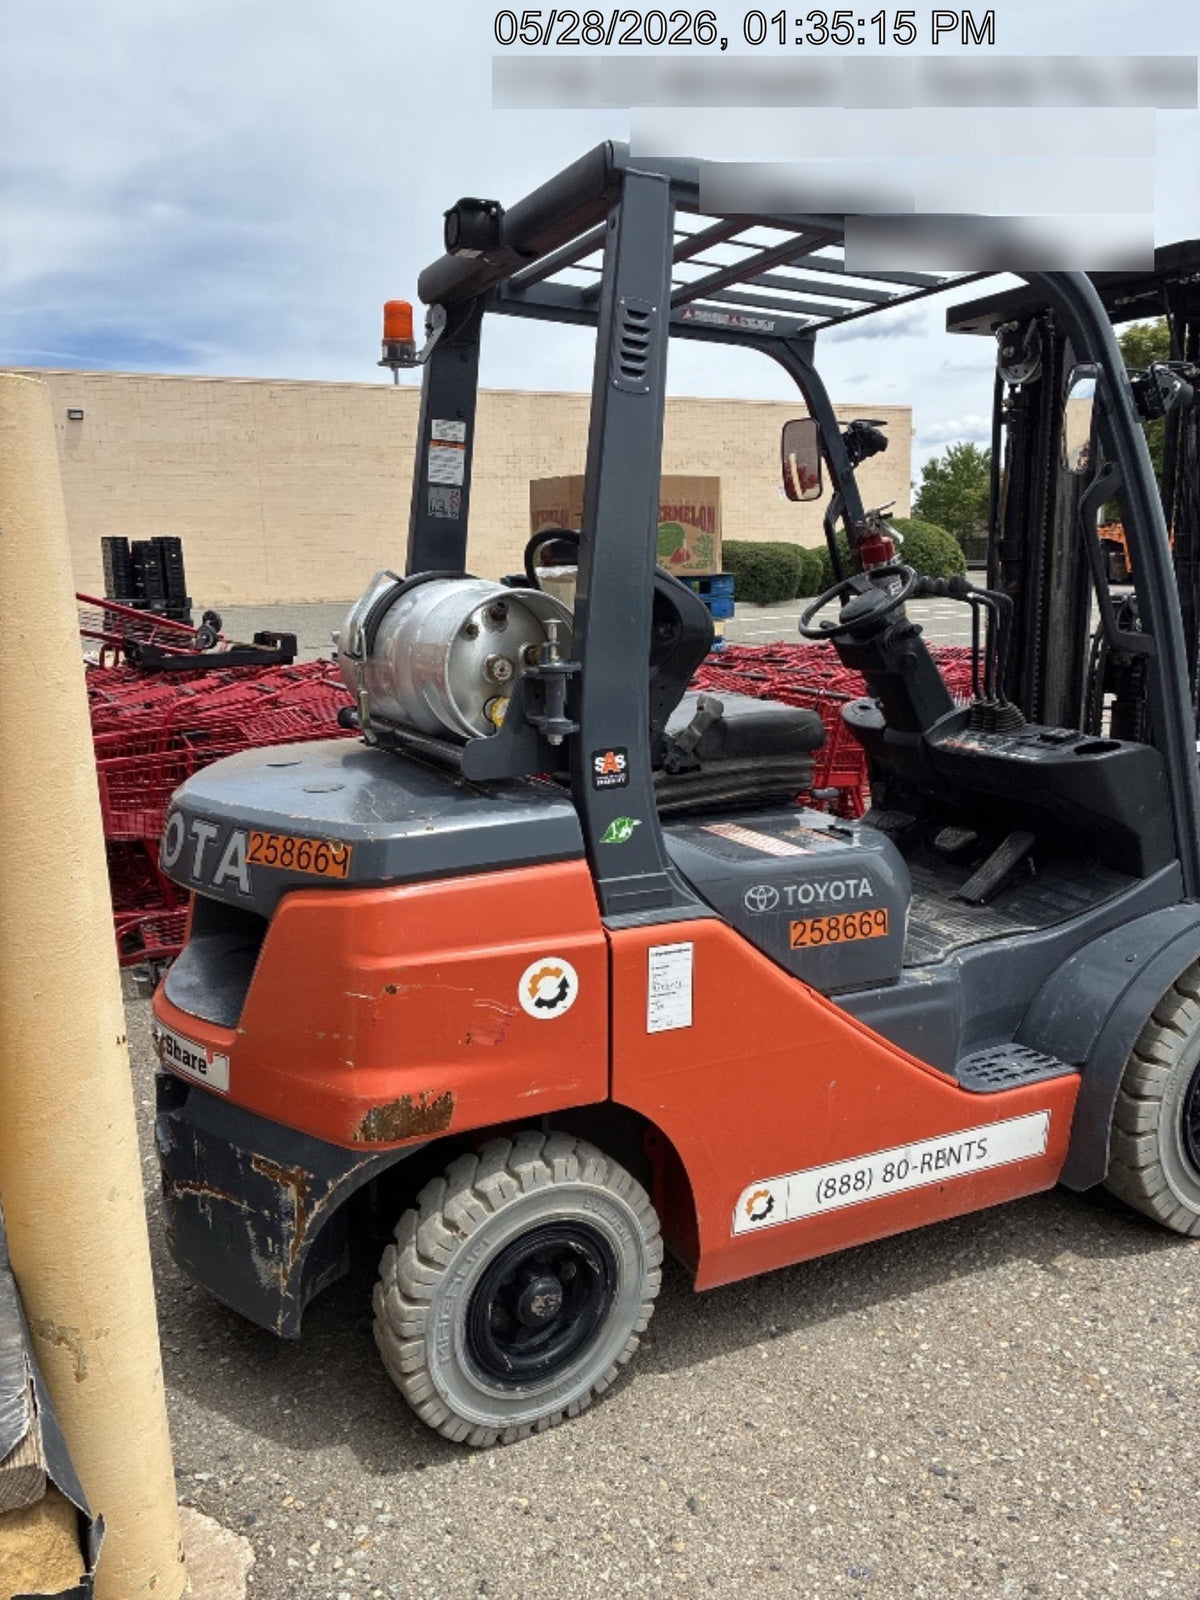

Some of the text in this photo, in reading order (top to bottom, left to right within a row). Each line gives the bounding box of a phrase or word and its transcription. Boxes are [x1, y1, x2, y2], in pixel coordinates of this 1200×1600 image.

[594, 751, 626, 774] SAS
[249, 833, 349, 877] 258669
[783, 878, 873, 906] TOYOTA
[792, 909, 888, 947] 258669
[816, 1138, 988, 1204] (888) 80-RENTS
